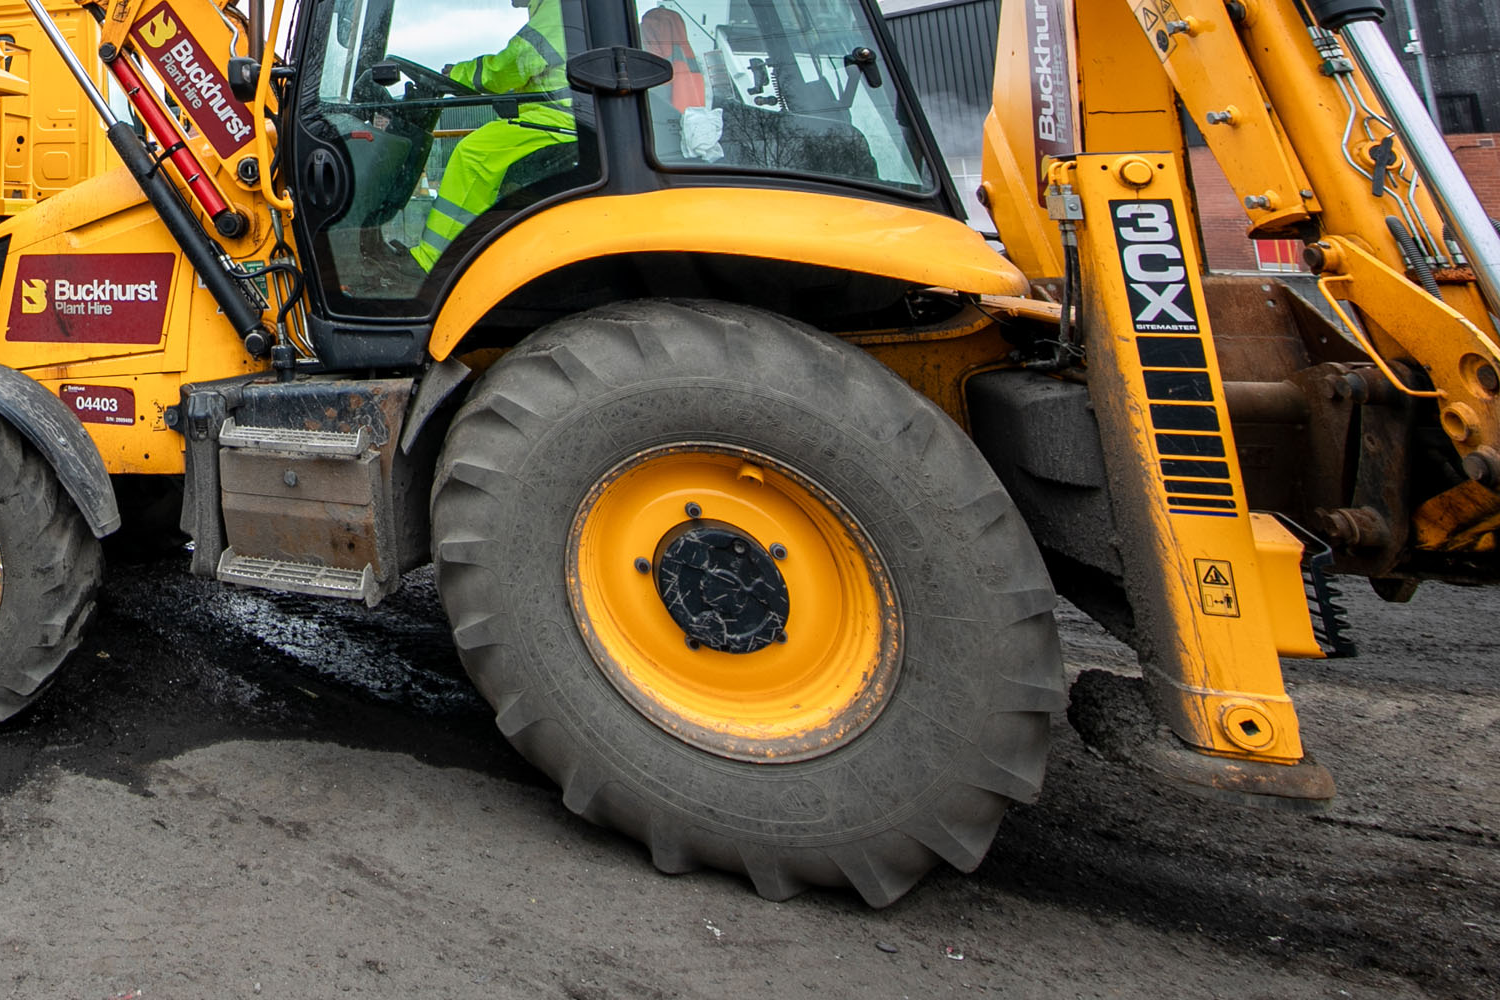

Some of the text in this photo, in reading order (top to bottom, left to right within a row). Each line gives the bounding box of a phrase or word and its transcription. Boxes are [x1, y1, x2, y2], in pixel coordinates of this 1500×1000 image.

[159, 53, 203, 109] Plant Hire
[170, 38, 251, 142] Buckhurst
[1053, 92, 1068, 144] Plant
[1116, 203, 1196, 322] 3CX
[55, 279, 158, 301] Buckhurst
[55, 302, 113, 315] Plant Hire
[76, 396, 118, 412] 04403
